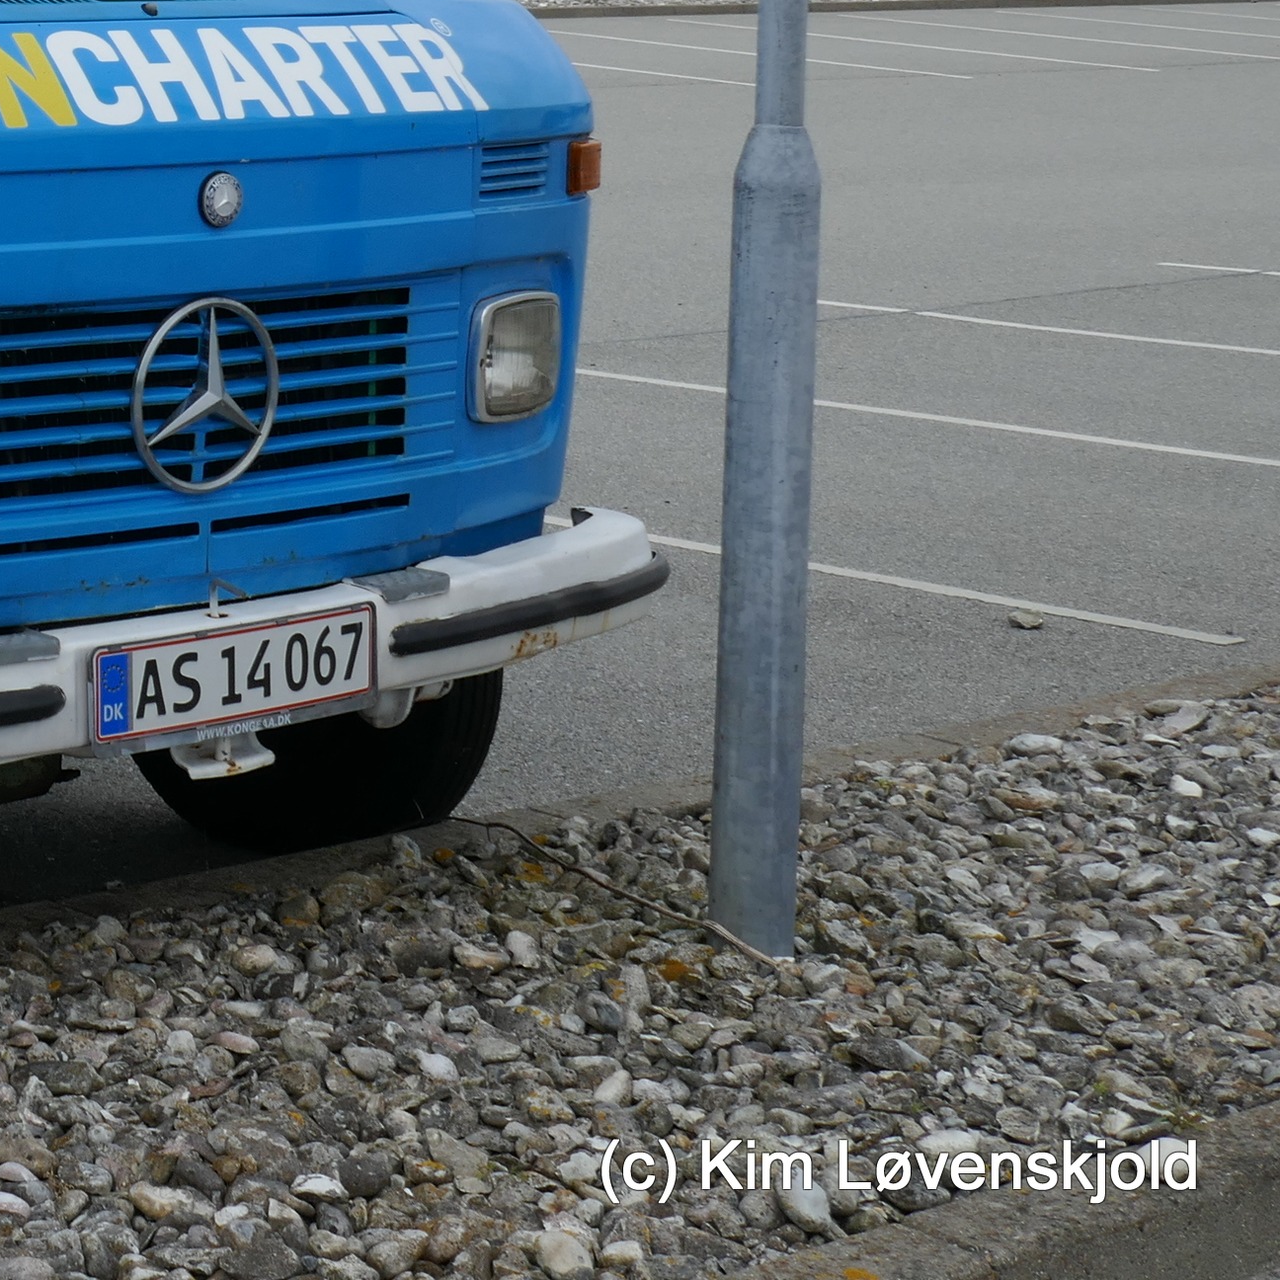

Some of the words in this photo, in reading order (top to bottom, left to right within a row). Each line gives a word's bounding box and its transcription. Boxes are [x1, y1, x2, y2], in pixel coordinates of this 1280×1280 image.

[135, 651, 202, 720] AS
[220, 639, 272, 707] 14
[284, 621, 363, 692] 067
[103, 702, 124, 723] DK
